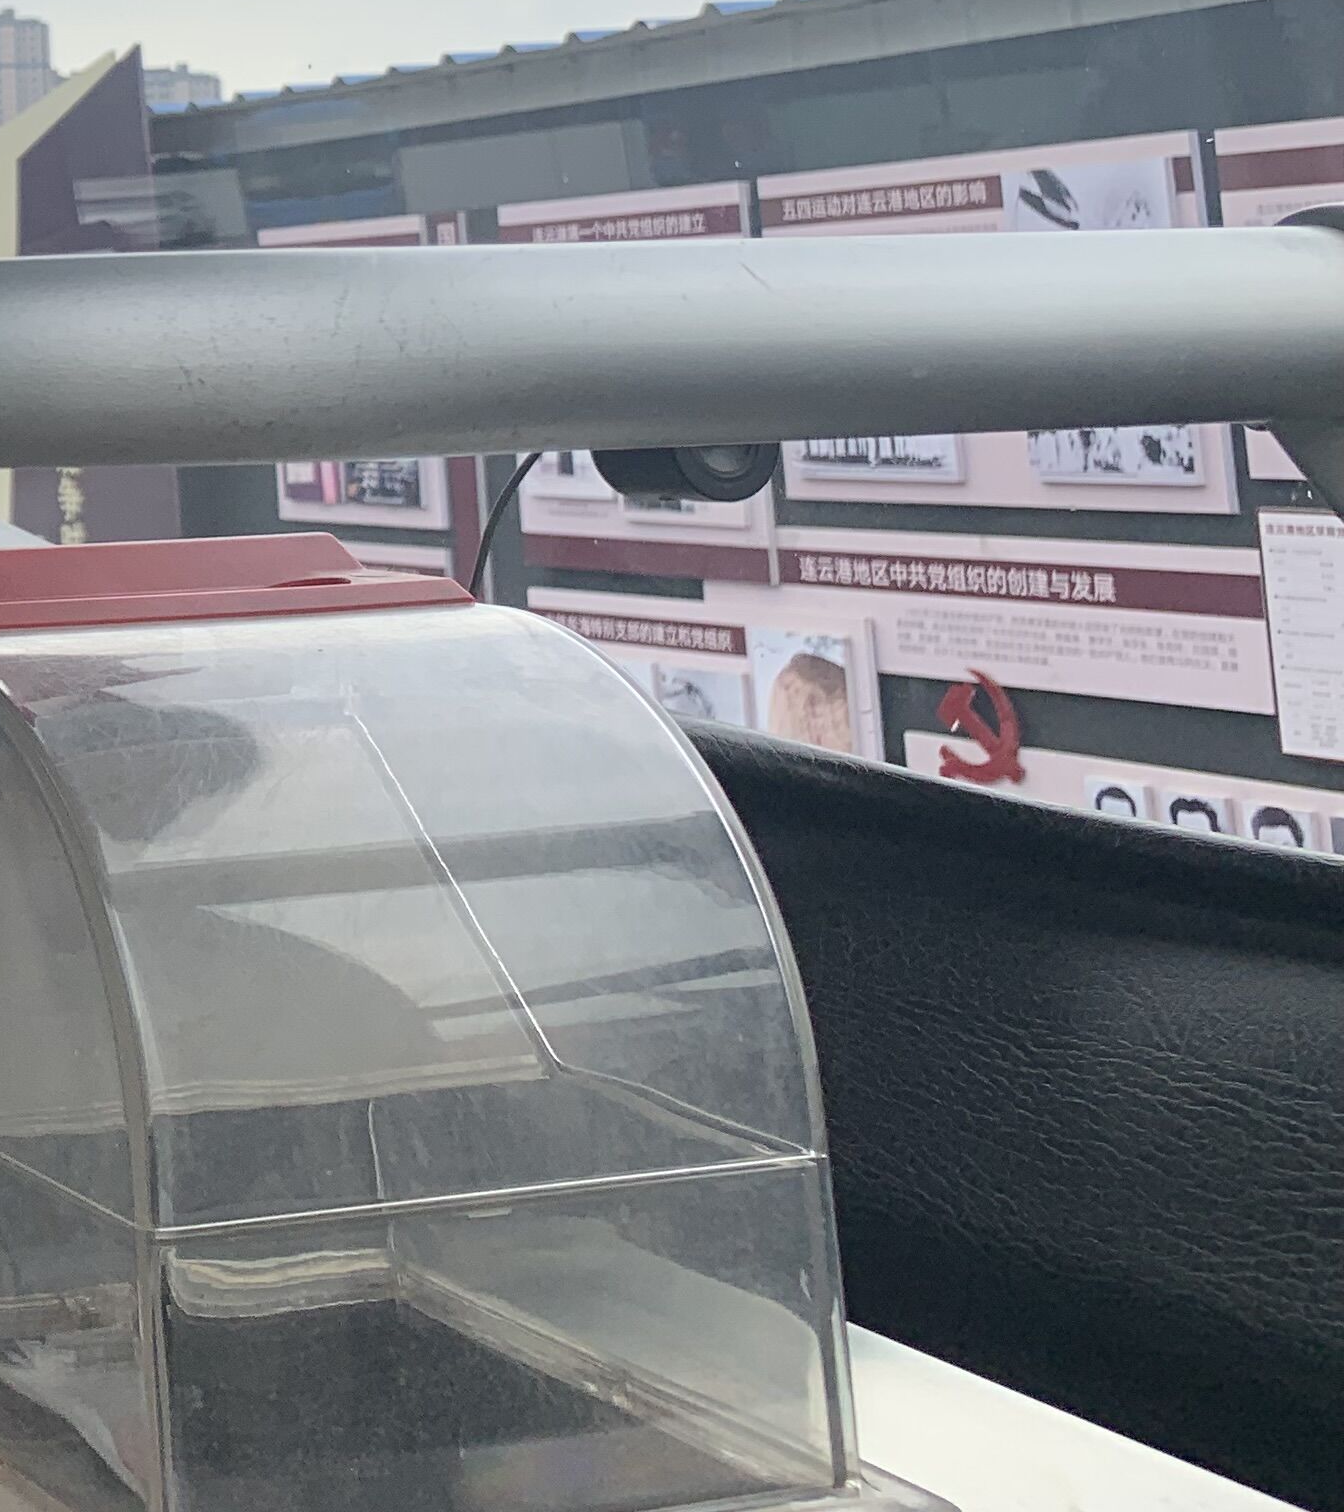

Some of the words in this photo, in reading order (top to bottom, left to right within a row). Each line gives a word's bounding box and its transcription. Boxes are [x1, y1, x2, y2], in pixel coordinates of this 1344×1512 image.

[782, 180, 987, 222] 五四运动对连云港地区的影响
[798, 553, 1118, 605] 连云港地区中共党组织的创建与发展
